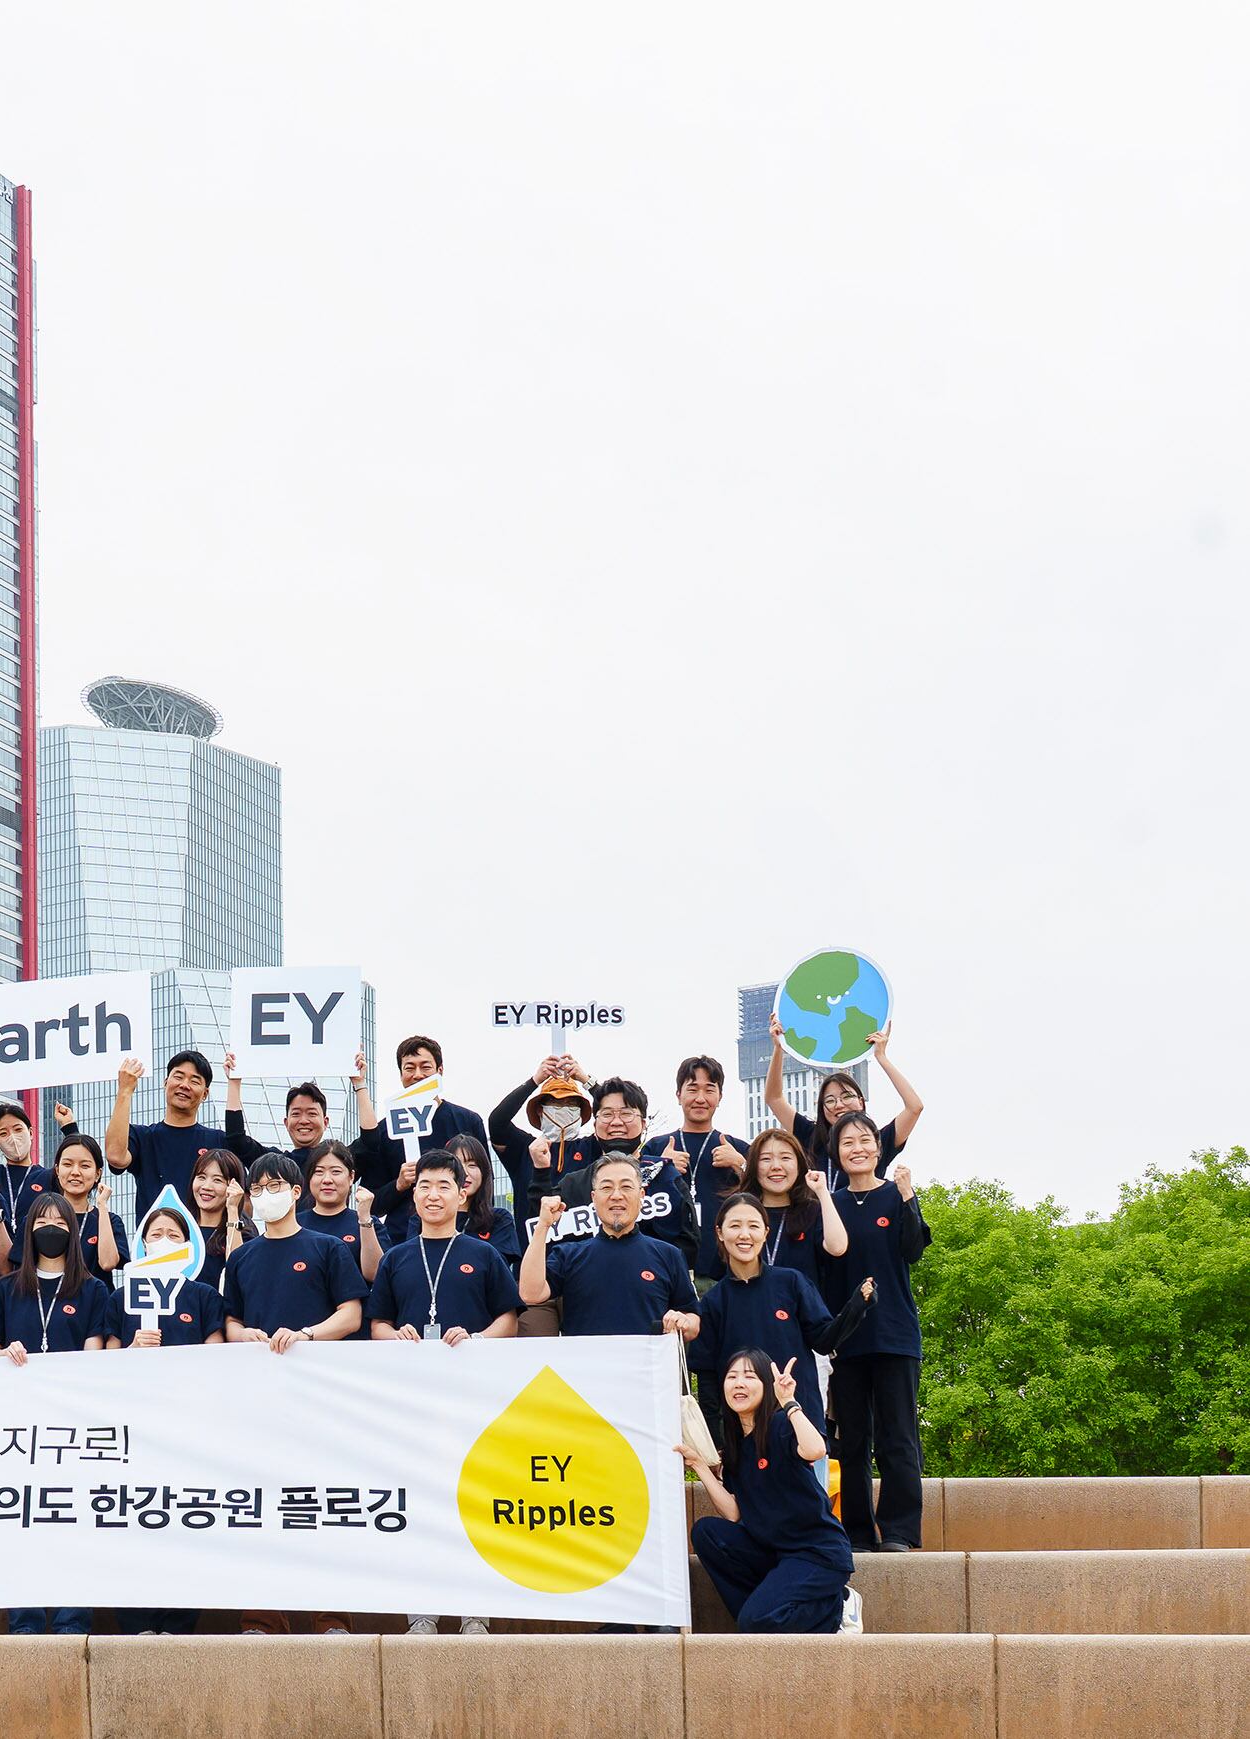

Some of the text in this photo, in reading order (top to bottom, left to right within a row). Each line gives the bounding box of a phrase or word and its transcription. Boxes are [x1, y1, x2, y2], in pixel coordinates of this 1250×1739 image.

[251, 992, 344, 1045] EY
[494, 1003, 623, 1028] EY Ripples
[390, 1105, 432, 1135] EY
[130, 1278, 179, 1309] EY
[0, 1425, 129, 1464] 지구로!
[531, 1455, 572, 1482] EY
[90, 1485, 262, 1529] 한강공원
[278, 1487, 407, 1532] 플로깅
[493, 1499, 614, 1531] Ripples
